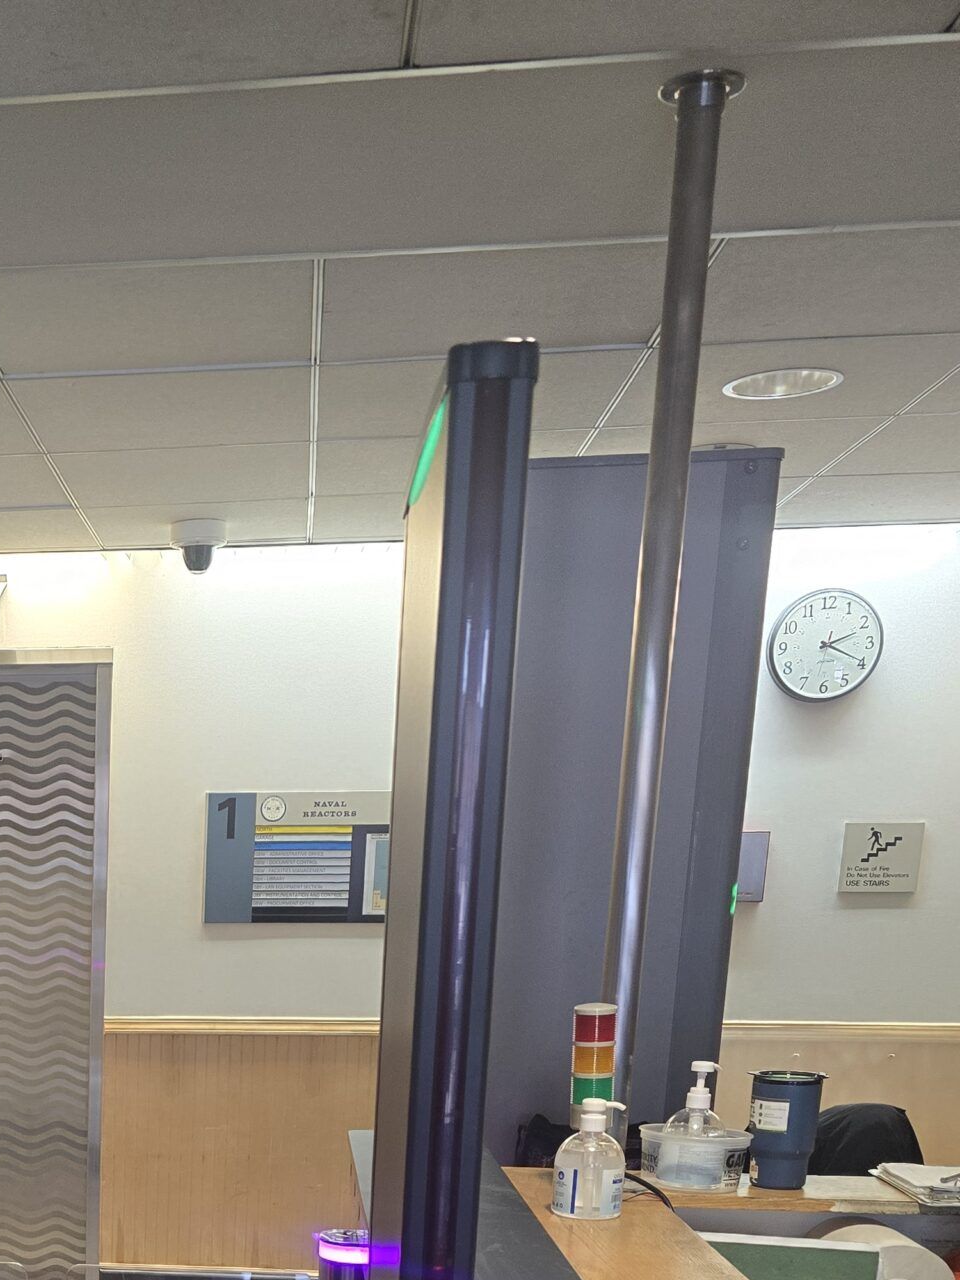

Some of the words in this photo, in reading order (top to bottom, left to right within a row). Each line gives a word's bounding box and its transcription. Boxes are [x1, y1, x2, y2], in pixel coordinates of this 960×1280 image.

[821, 596, 837, 610] 12
[846, 602, 853, 615] 1
[802, 604, 814, 618] 11
[783, 621, 797, 634] 10
[859, 615, 870, 629] 2
[778, 642, 788, 656] 9
[865, 636, 875, 650] 3
[783, 661, 793, 675] 8
[857, 656, 866, 670] 4
[799, 676, 808, 690] 7
[819, 679, 829, 694] 6
[839, 673, 849, 687] 5
[217, 797, 237, 839] 1
